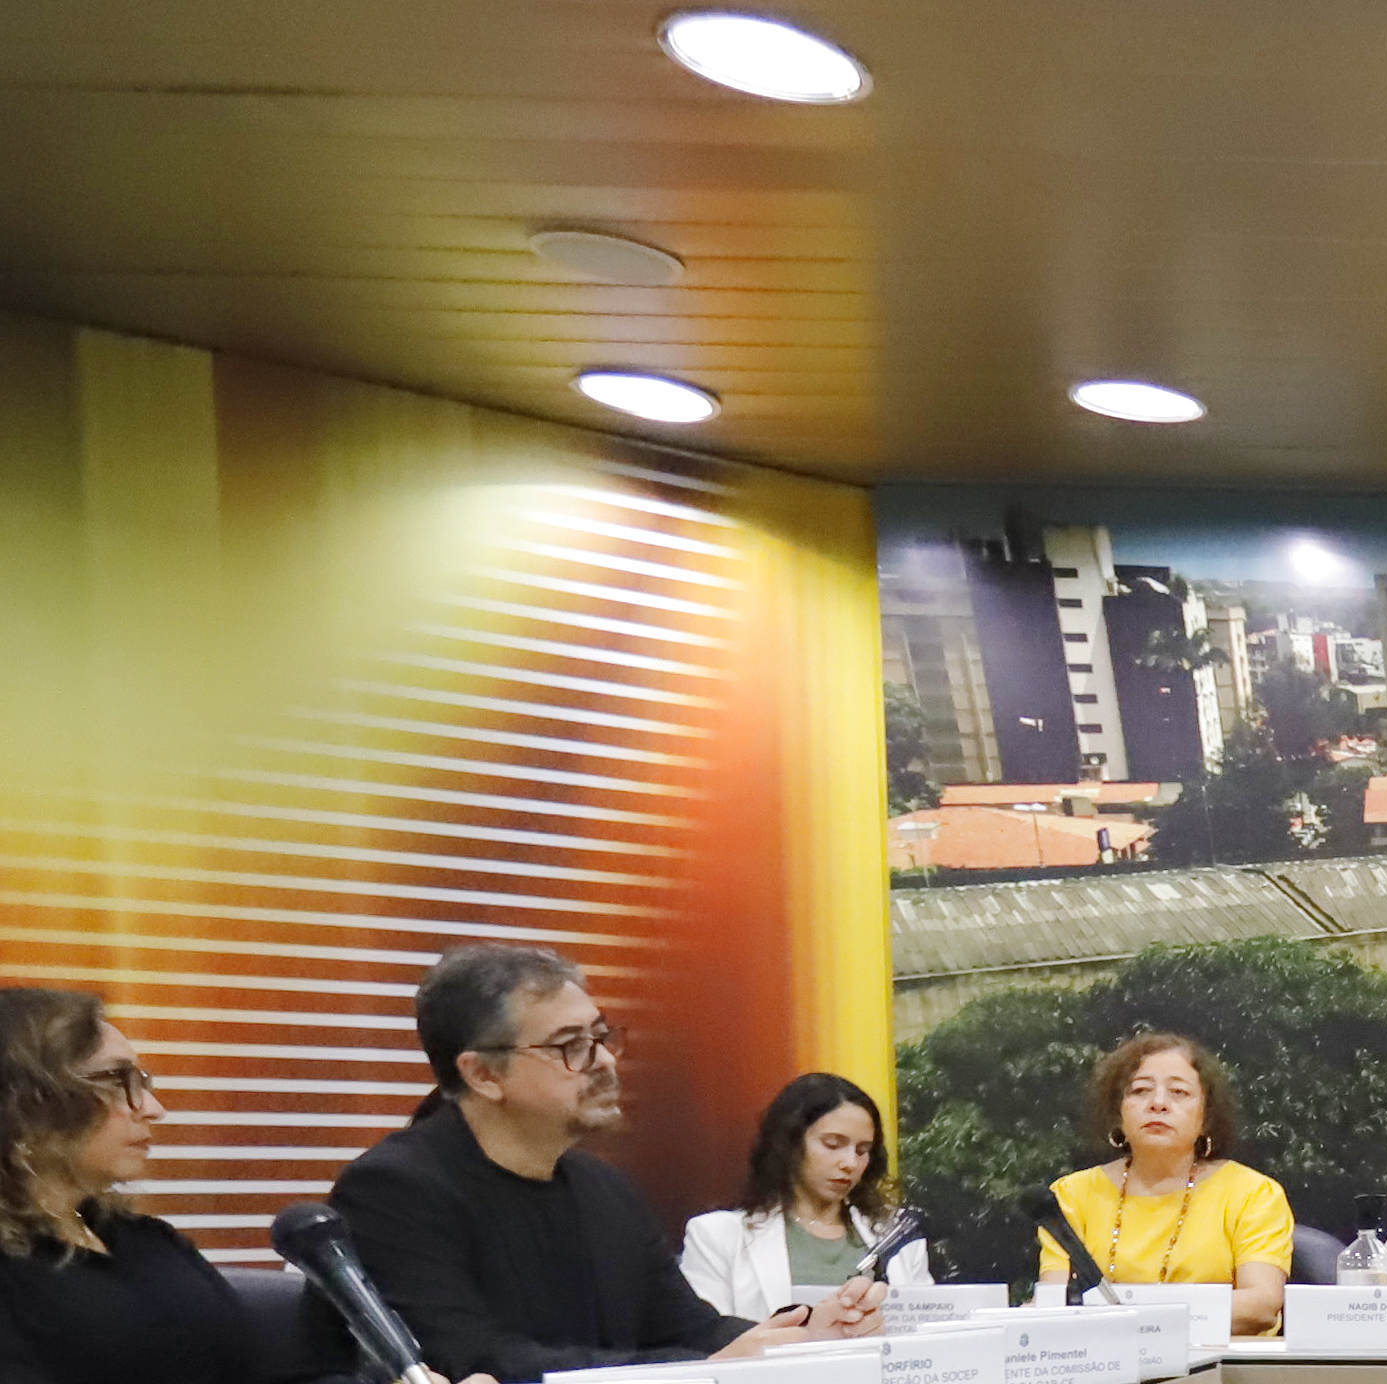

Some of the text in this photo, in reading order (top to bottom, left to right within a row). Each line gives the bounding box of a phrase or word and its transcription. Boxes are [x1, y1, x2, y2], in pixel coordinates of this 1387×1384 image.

[908, 1303, 954, 1311] SAMPAIO
[1348, 1303, 1378, 1311] NAGIB
[1327, 1314, 1385, 1322] PRESIDENTE
[1040, 1348, 1087, 1361] Pimentel
[1034, 1367, 1049, 1377] DA
[1051, 1360, 1105, 1376] COMISSÃO
[1107, 1361, 1121, 1371] DE
[924, 1374, 939, 1384] DA
[942, 1369, 979, 1383] SOCEP
